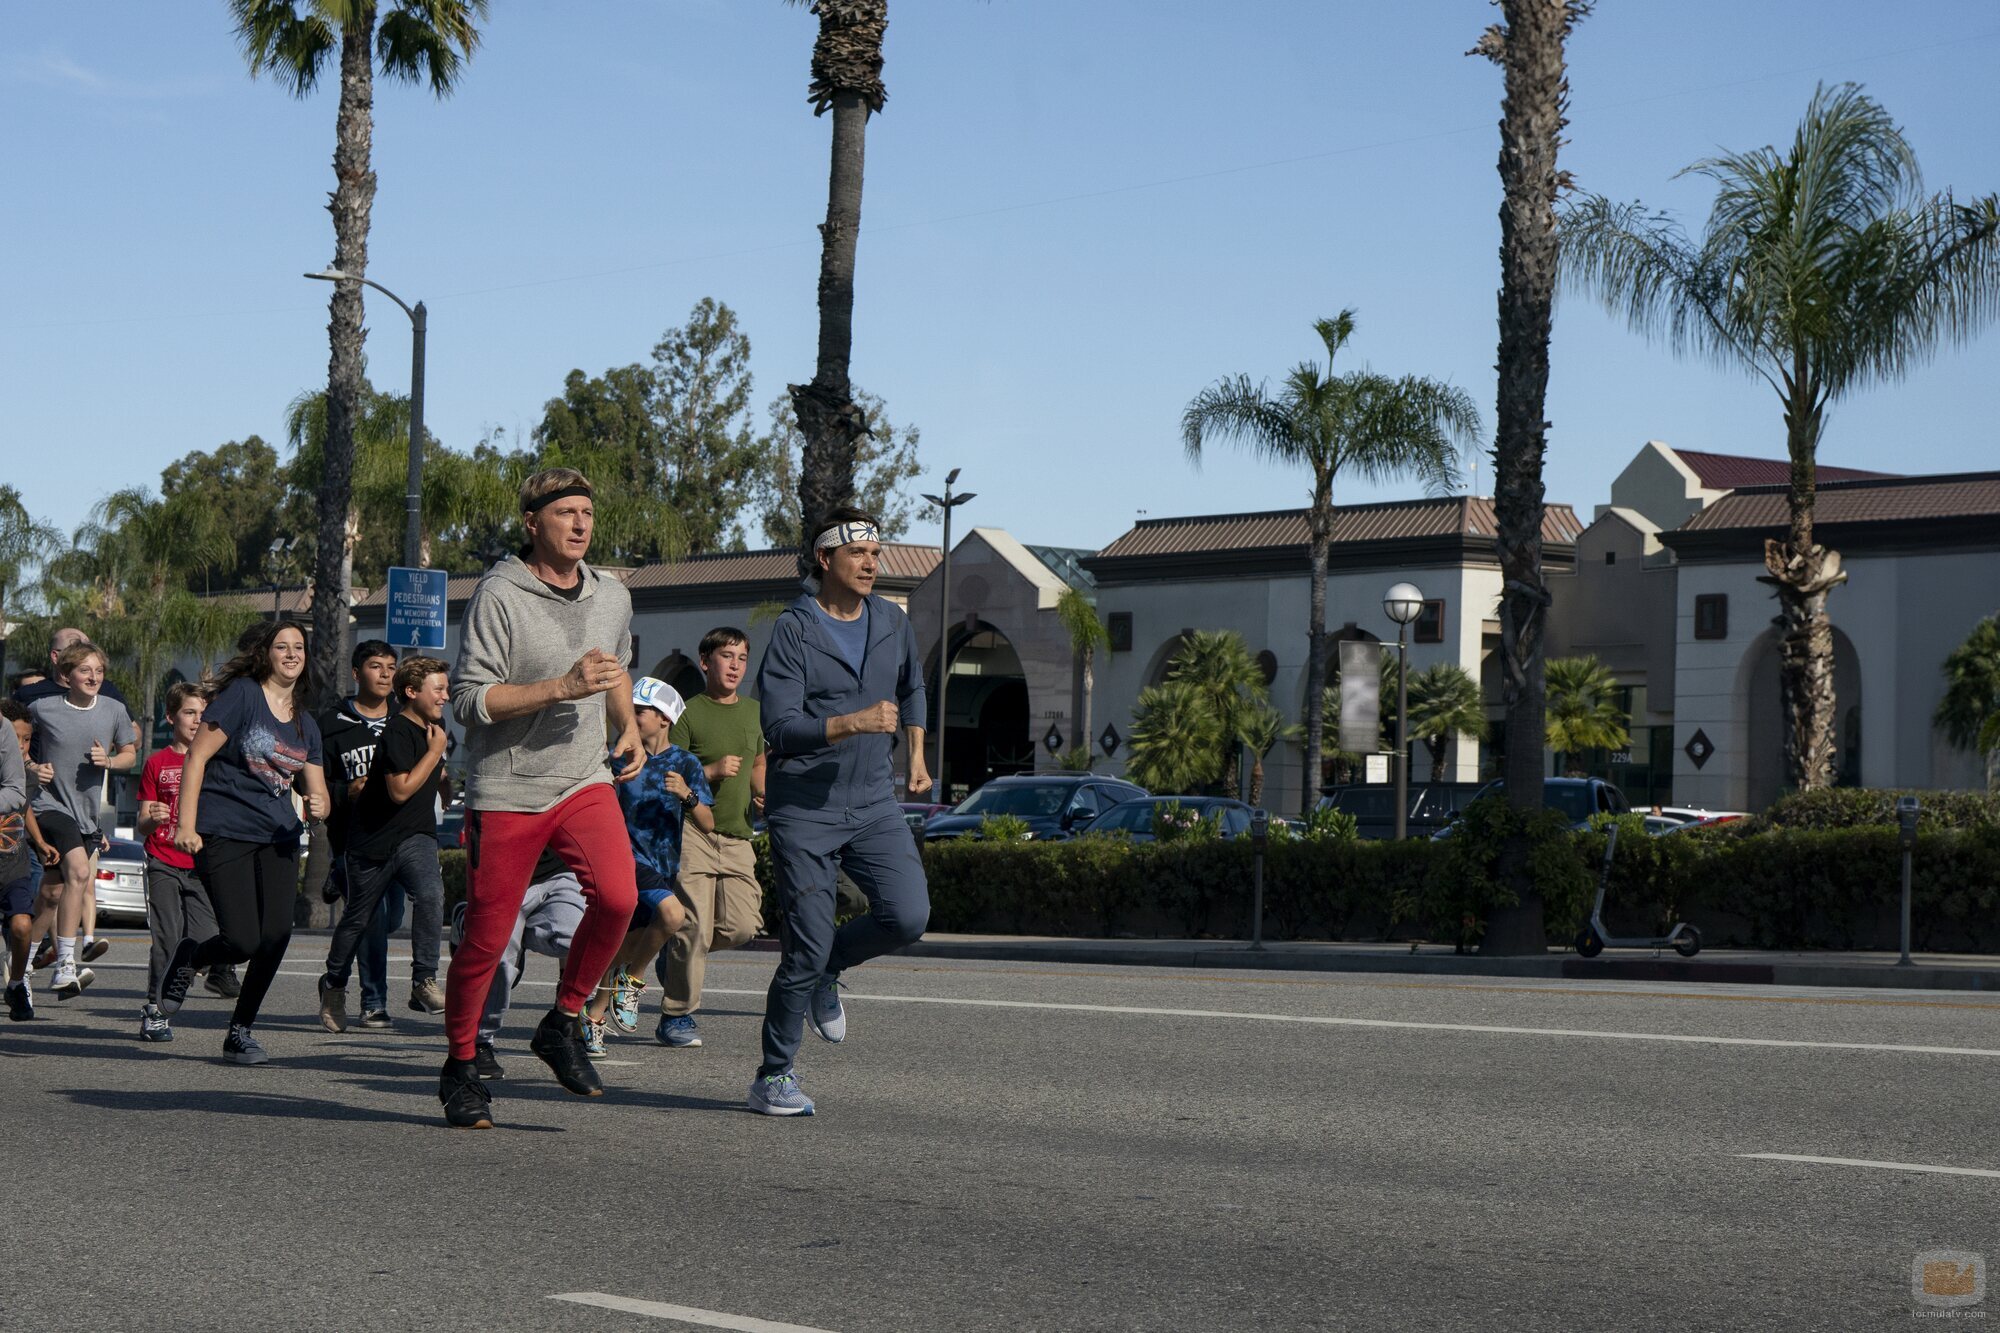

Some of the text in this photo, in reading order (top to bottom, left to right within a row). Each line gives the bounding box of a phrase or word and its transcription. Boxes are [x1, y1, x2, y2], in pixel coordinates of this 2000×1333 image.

[408, 572, 428, 583] YIELD
[413, 583, 422, 593] TO
[393, 592, 441, 605] PEDESTRIANS
[395, 608, 438, 618] IN MEMORY OF
